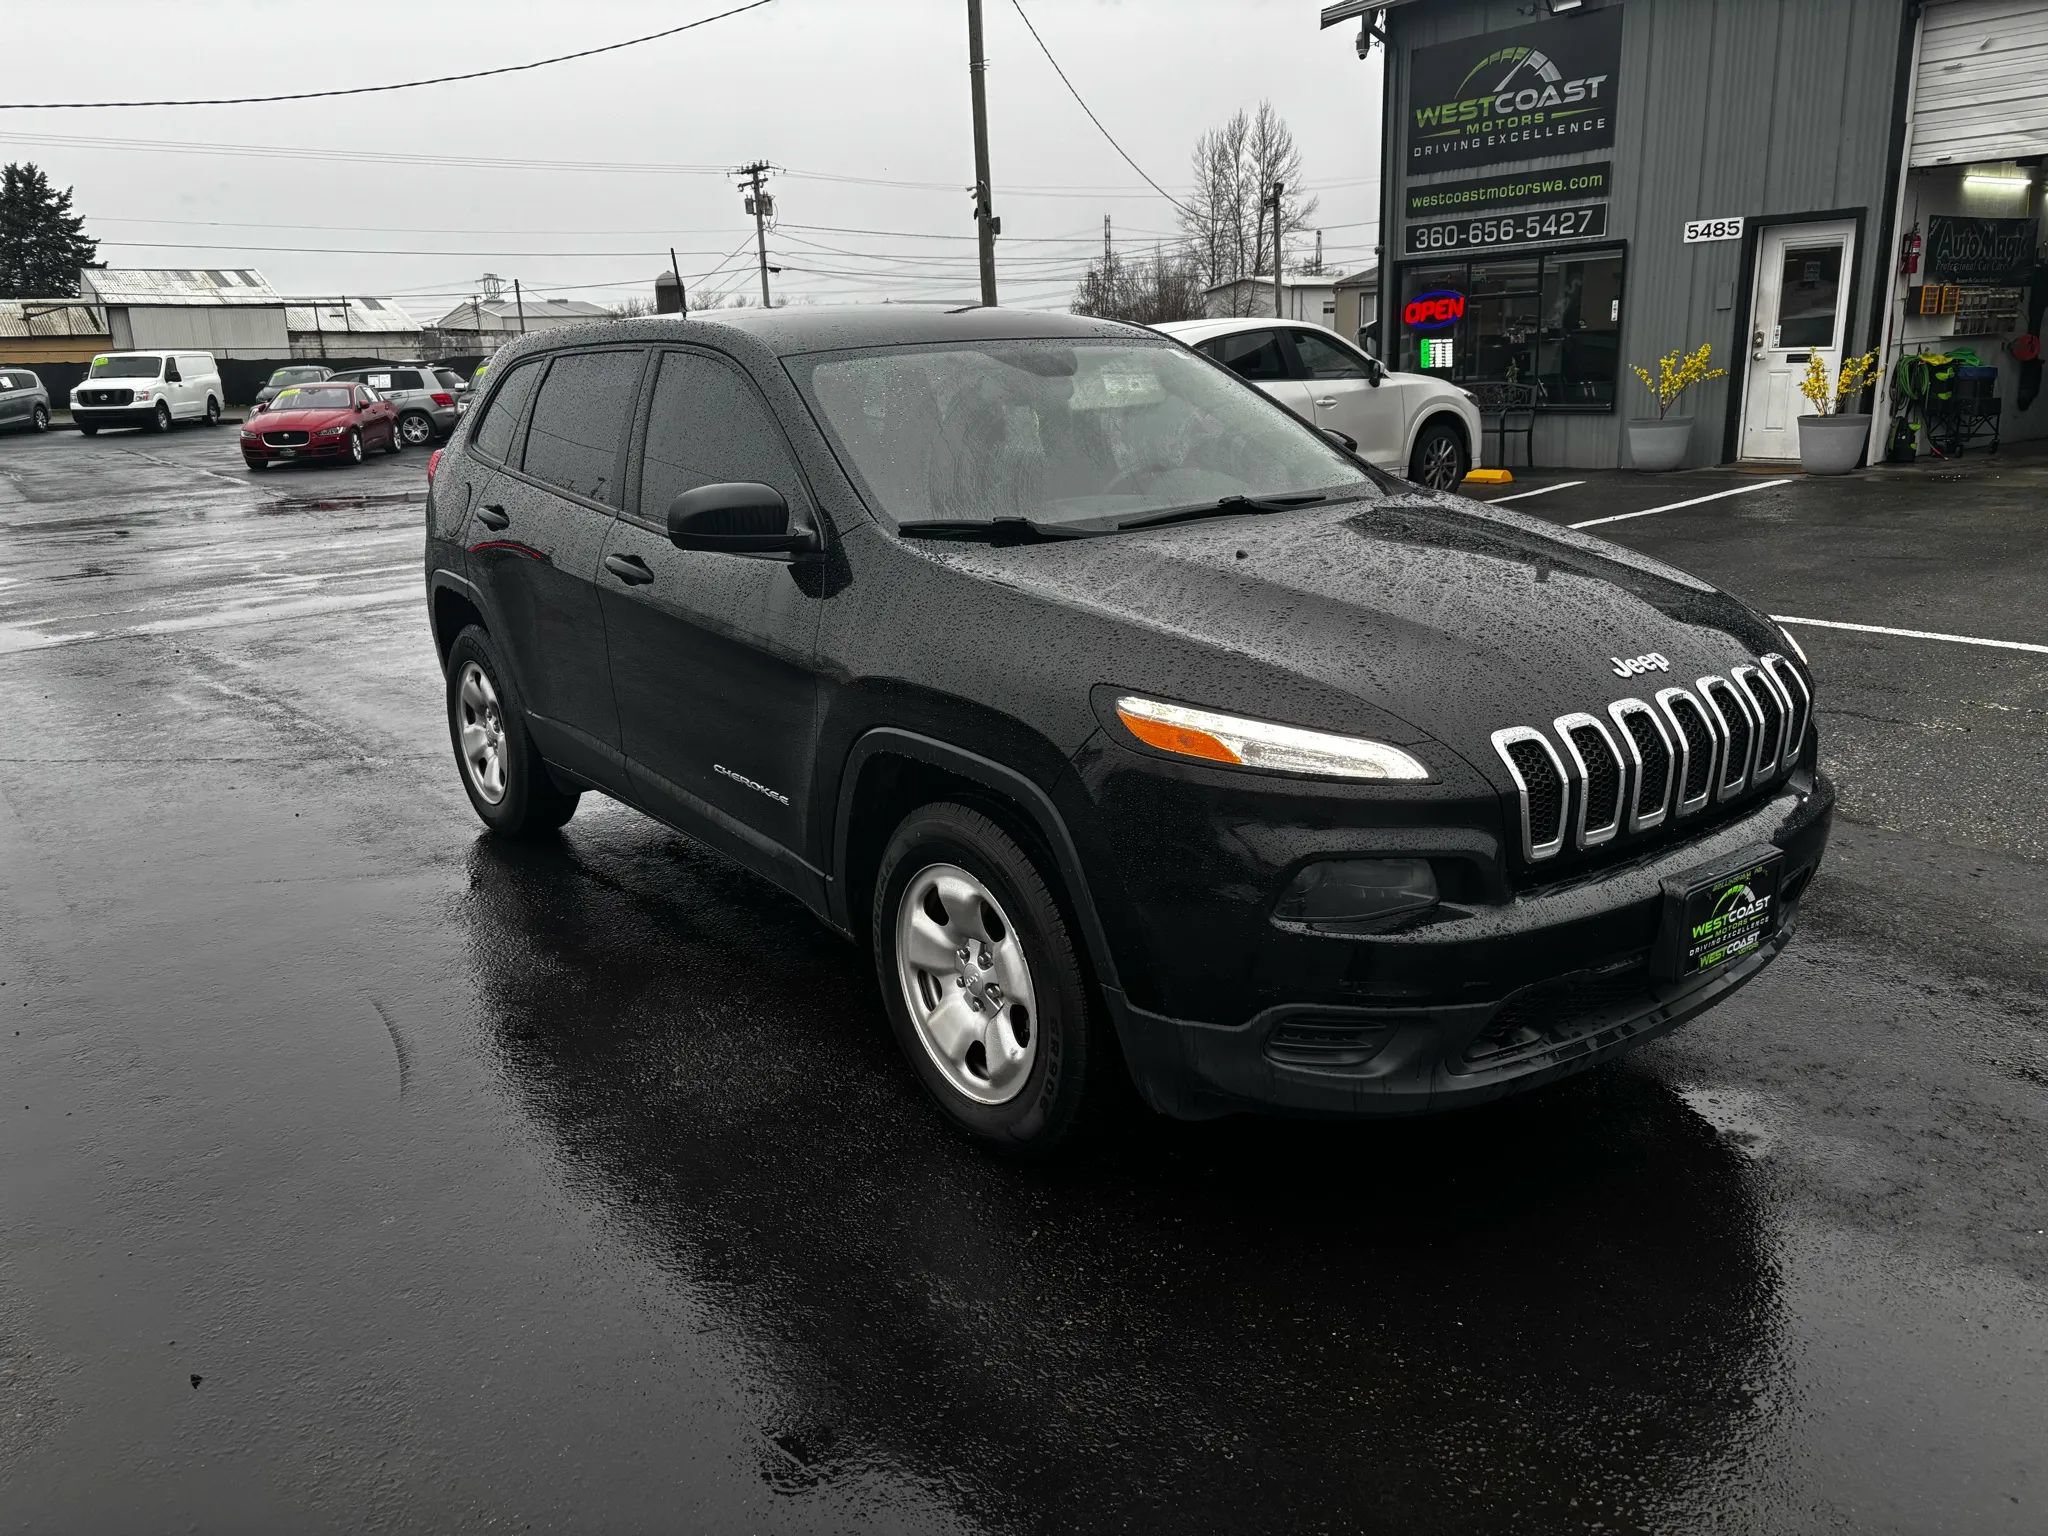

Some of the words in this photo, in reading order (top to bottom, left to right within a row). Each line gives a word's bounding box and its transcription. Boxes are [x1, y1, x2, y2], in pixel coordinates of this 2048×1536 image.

[1415, 74, 1608, 129] WESTCOAST
[1413, 138, 1481, 157] DRIVING
[1488, 118, 1606, 146] EXCELLENCE
[1466, 112, 1545, 135] MOTORS
[1411, 174, 1603, 208] westcoastmotorswa.com
[1415, 210, 1593, 249] 360-656-5427
[1687, 220, 1740, 239] 5485
[1405, 296, 1465, 323] OPEN
[1610, 652, 1670, 678] Jeep
[713, 764, 790, 806] CHEROKEE
[1692, 895, 1771, 938] WESTCOAST
[1714, 918, 1748, 937] MOTORS
[1689, 937, 1721, 956] DRIVING
[1722, 916, 1770, 941] EXCELLENCE
[1700, 931, 1761, 968] WESTCOAST
